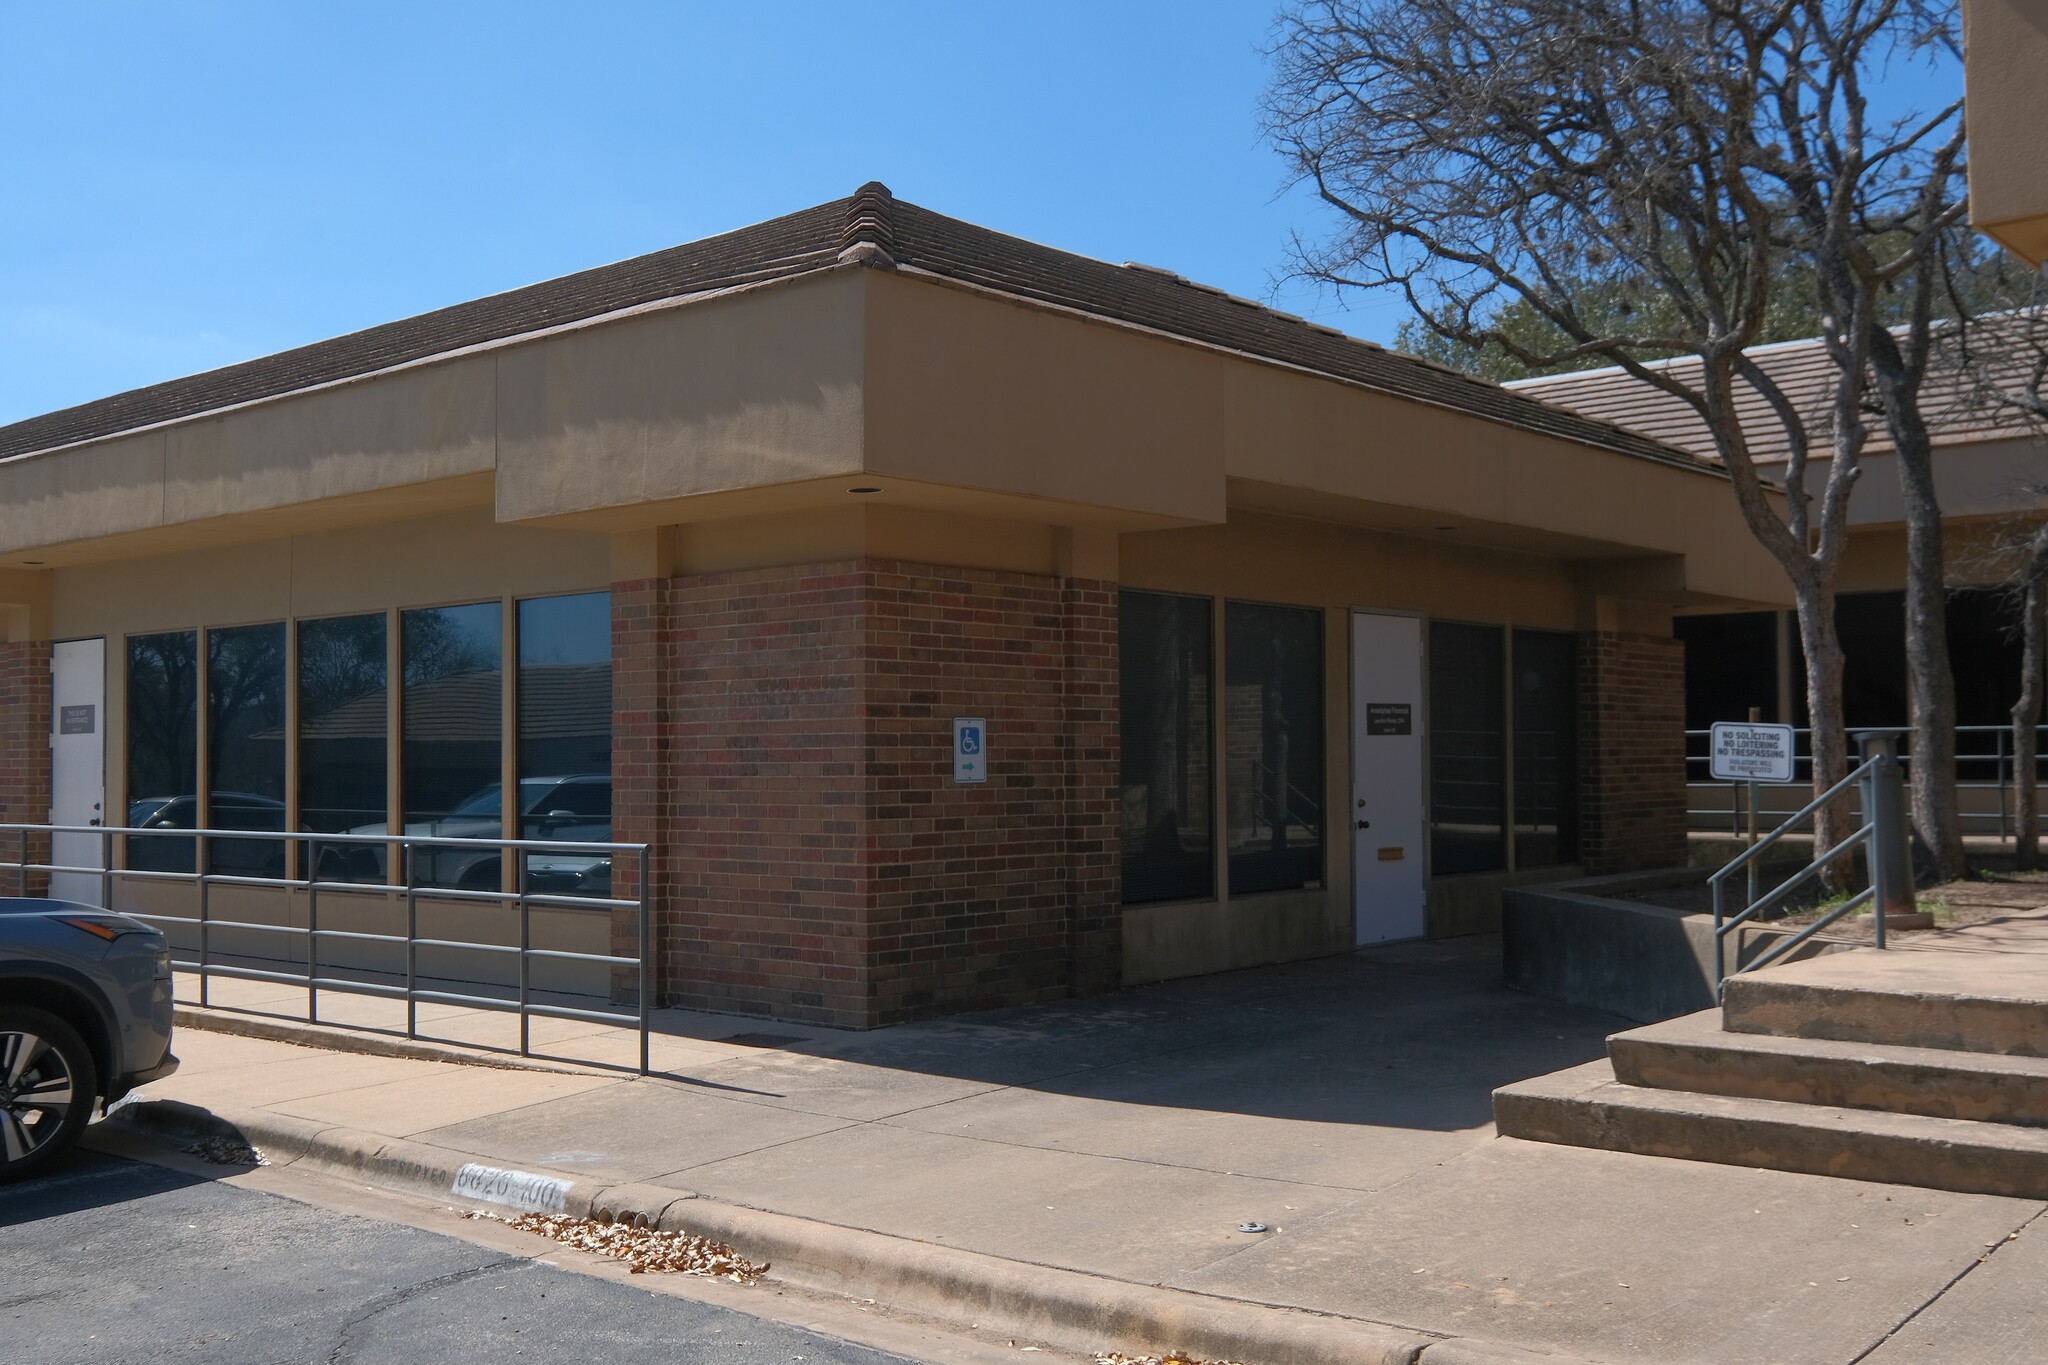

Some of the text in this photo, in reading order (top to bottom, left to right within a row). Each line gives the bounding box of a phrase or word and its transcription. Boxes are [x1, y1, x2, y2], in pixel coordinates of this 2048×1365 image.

[1722, 731, 1780, 741] NO SOLICITING
[1723, 740, 1779, 749] NO LOITERING
[1717, 748, 1785, 758] NO TRESPASSING
